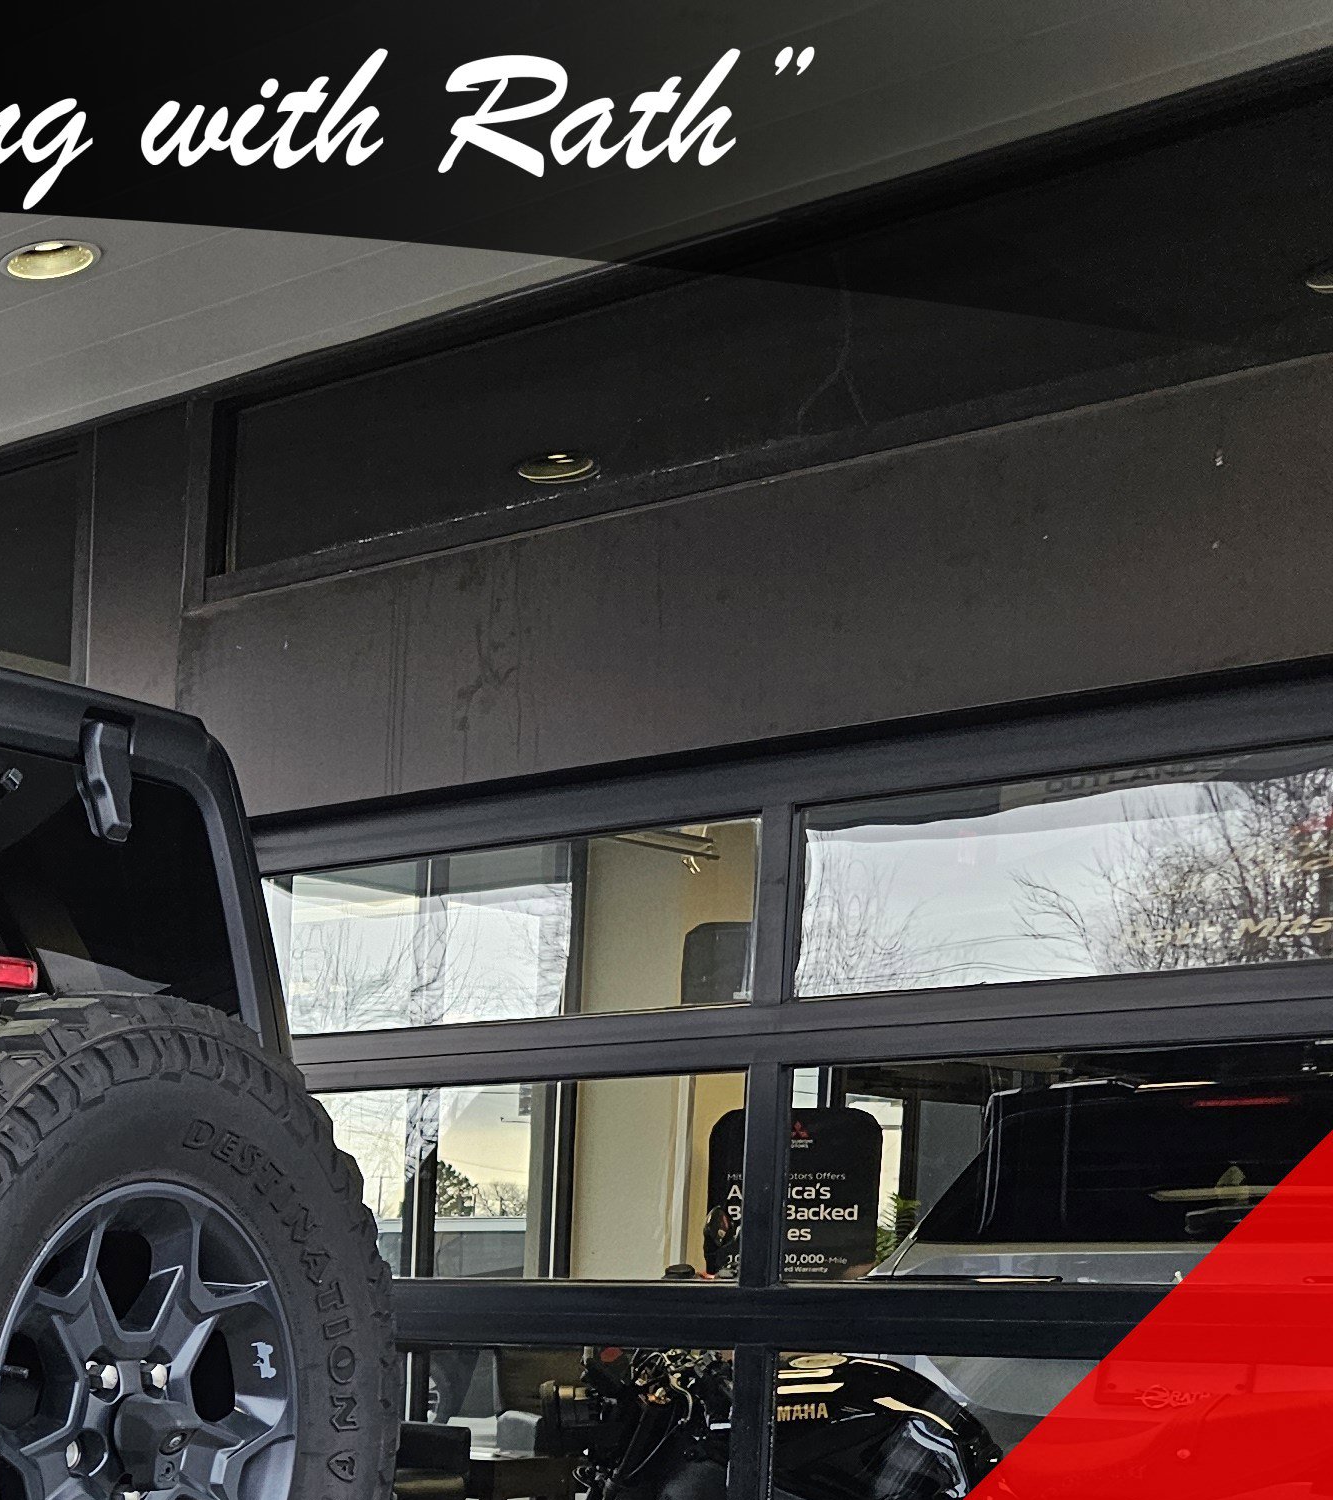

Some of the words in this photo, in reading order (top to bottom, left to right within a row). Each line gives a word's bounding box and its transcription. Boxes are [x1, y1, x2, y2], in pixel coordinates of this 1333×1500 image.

[816, 1172, 846, 1180] Offers
[787, 1204, 858, 1220] Backed
[182, 1118, 360, 1433] DESTINATION
[777, 1402, 829, 1421] MAHA
